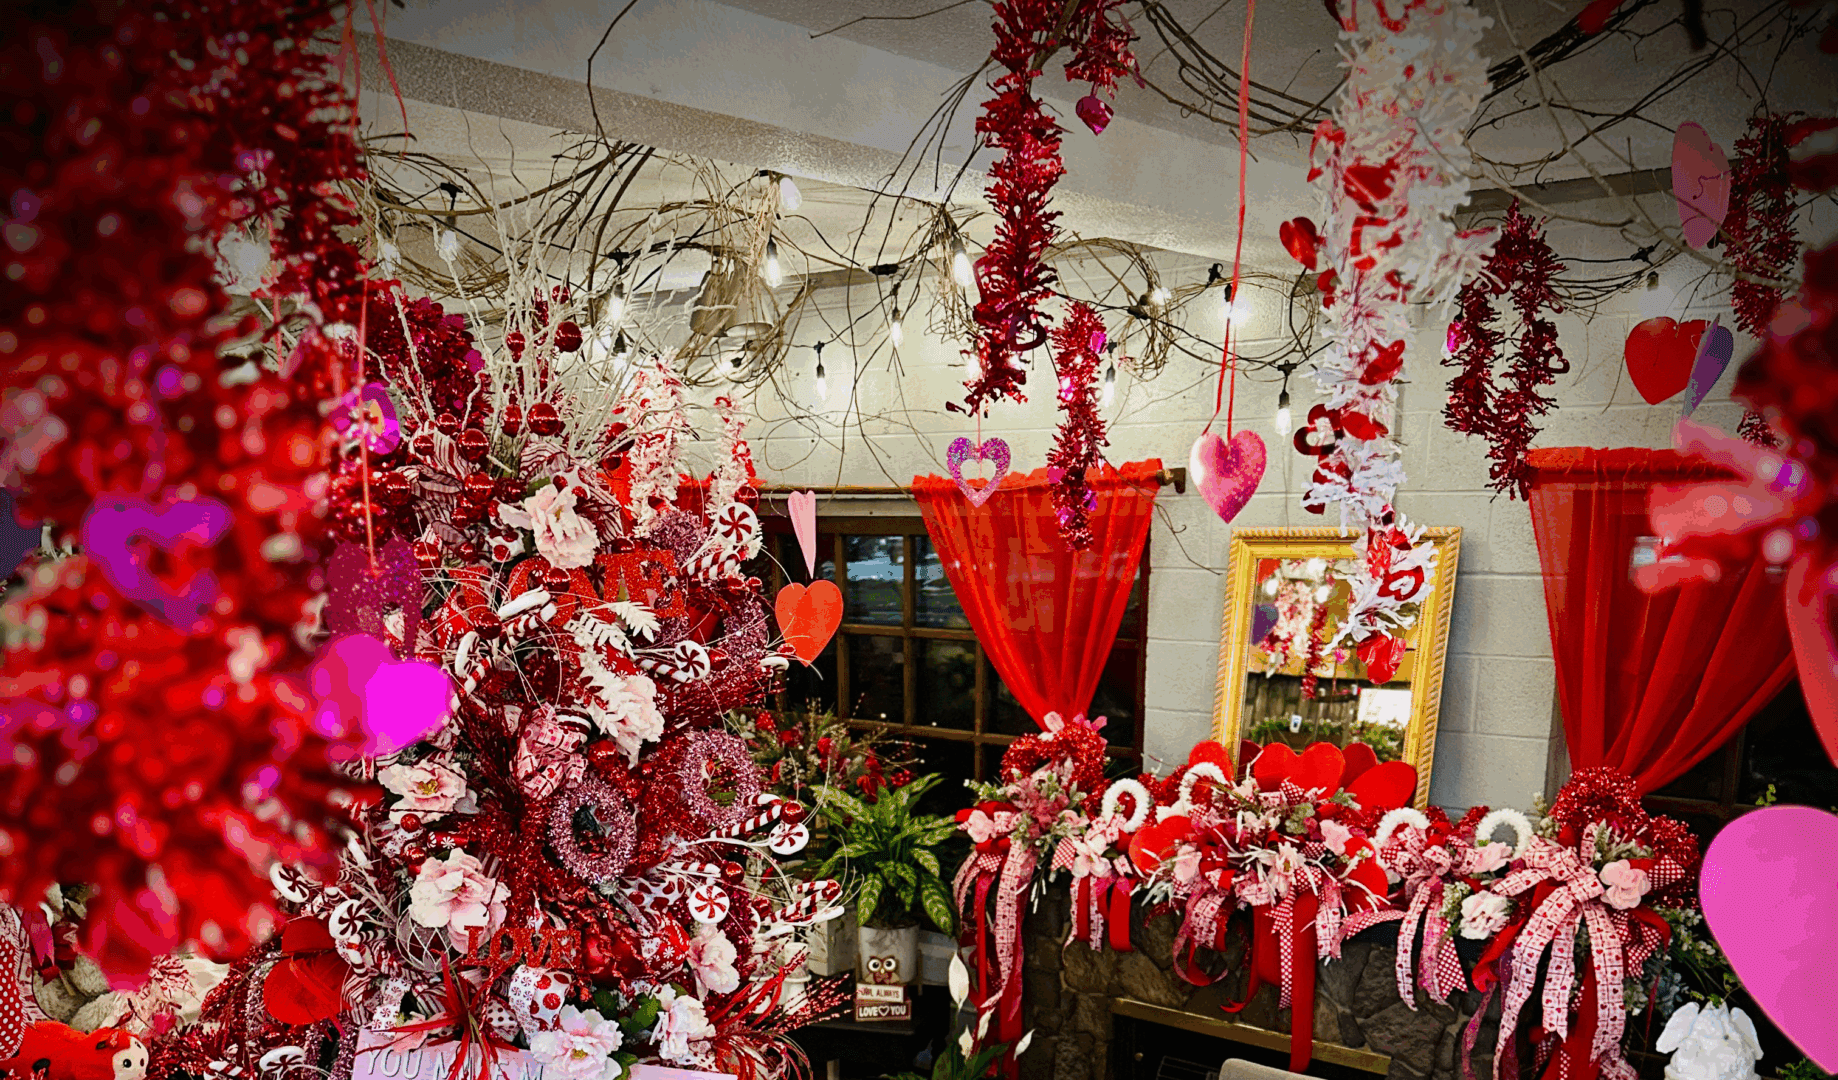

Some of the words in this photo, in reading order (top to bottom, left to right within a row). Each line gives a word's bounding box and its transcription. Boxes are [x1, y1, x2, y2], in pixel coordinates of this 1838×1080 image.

[462, 925, 582, 970] LOVE
[876, 989, 900, 999] ALWAYS
[859, 1006, 878, 1018] LOVE
[890, 1005, 907, 1016] YOU
[366, 1046, 423, 1080] YOU
